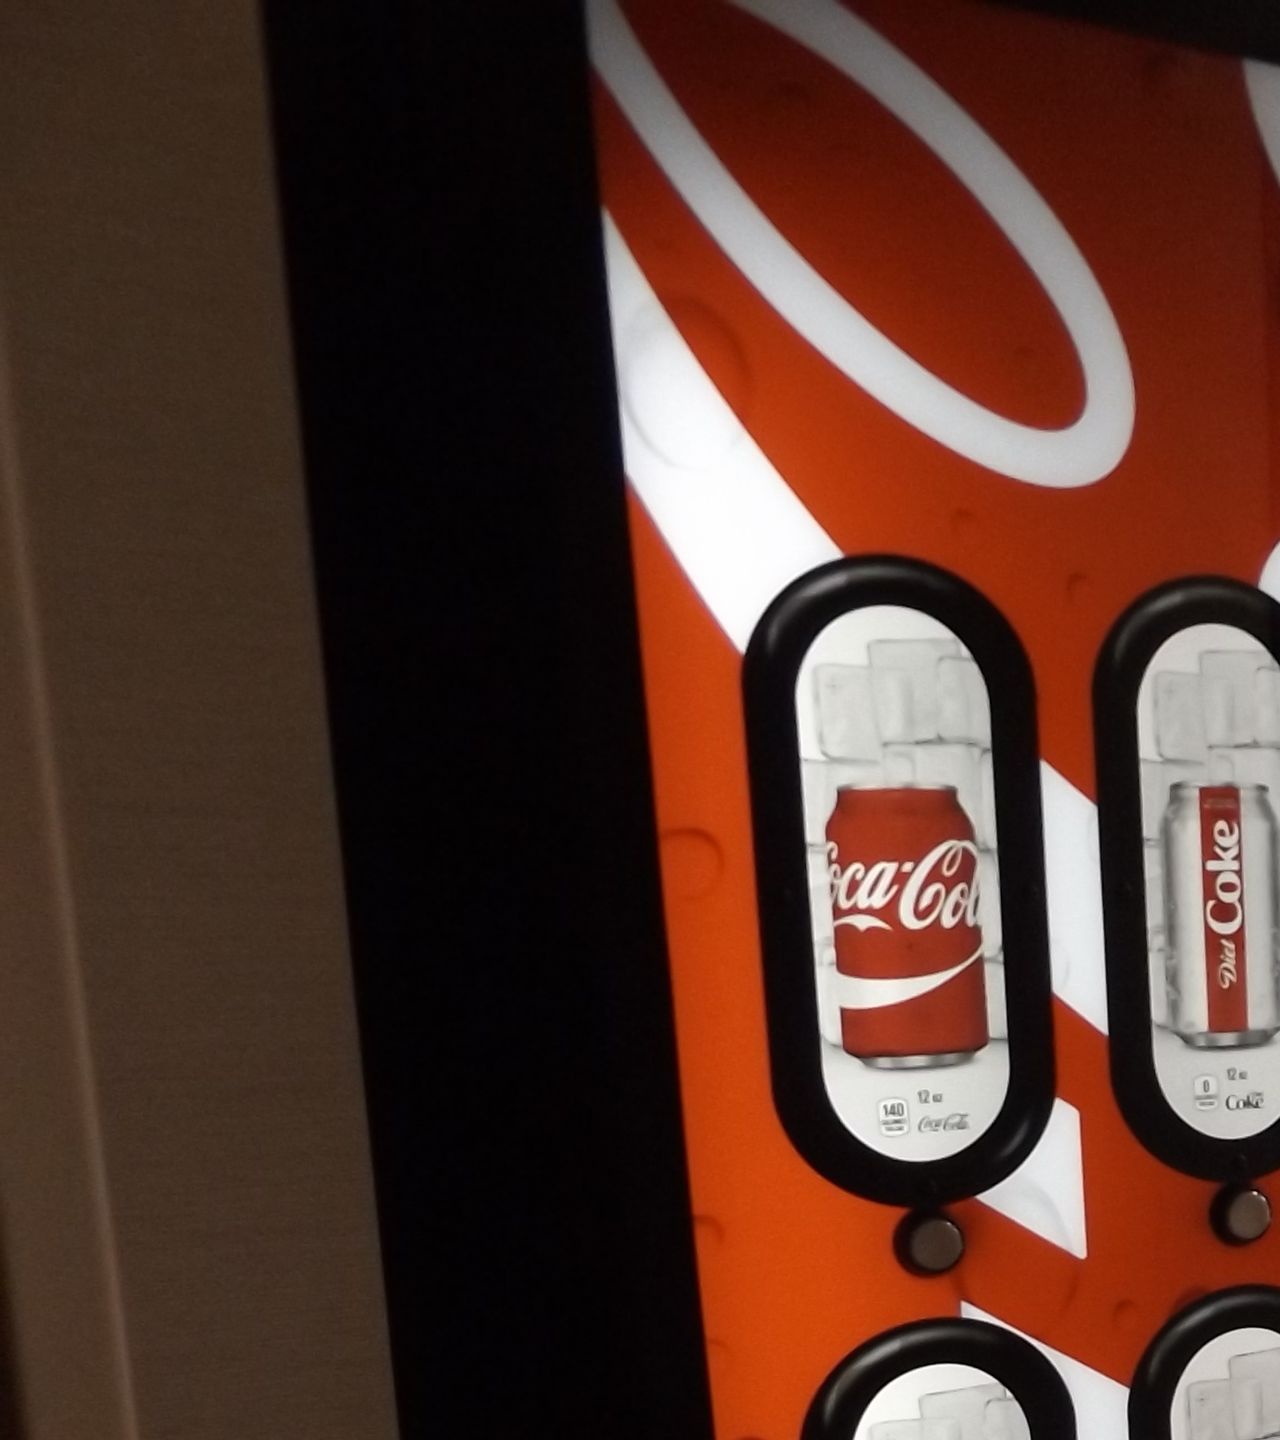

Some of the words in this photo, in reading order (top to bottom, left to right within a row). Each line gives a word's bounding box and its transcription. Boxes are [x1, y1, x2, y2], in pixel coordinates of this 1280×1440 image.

[1206, 819, 1243, 935] Coke
[917, 1090, 931, 1104] 12
[883, 1102, 904, 1118] 140
